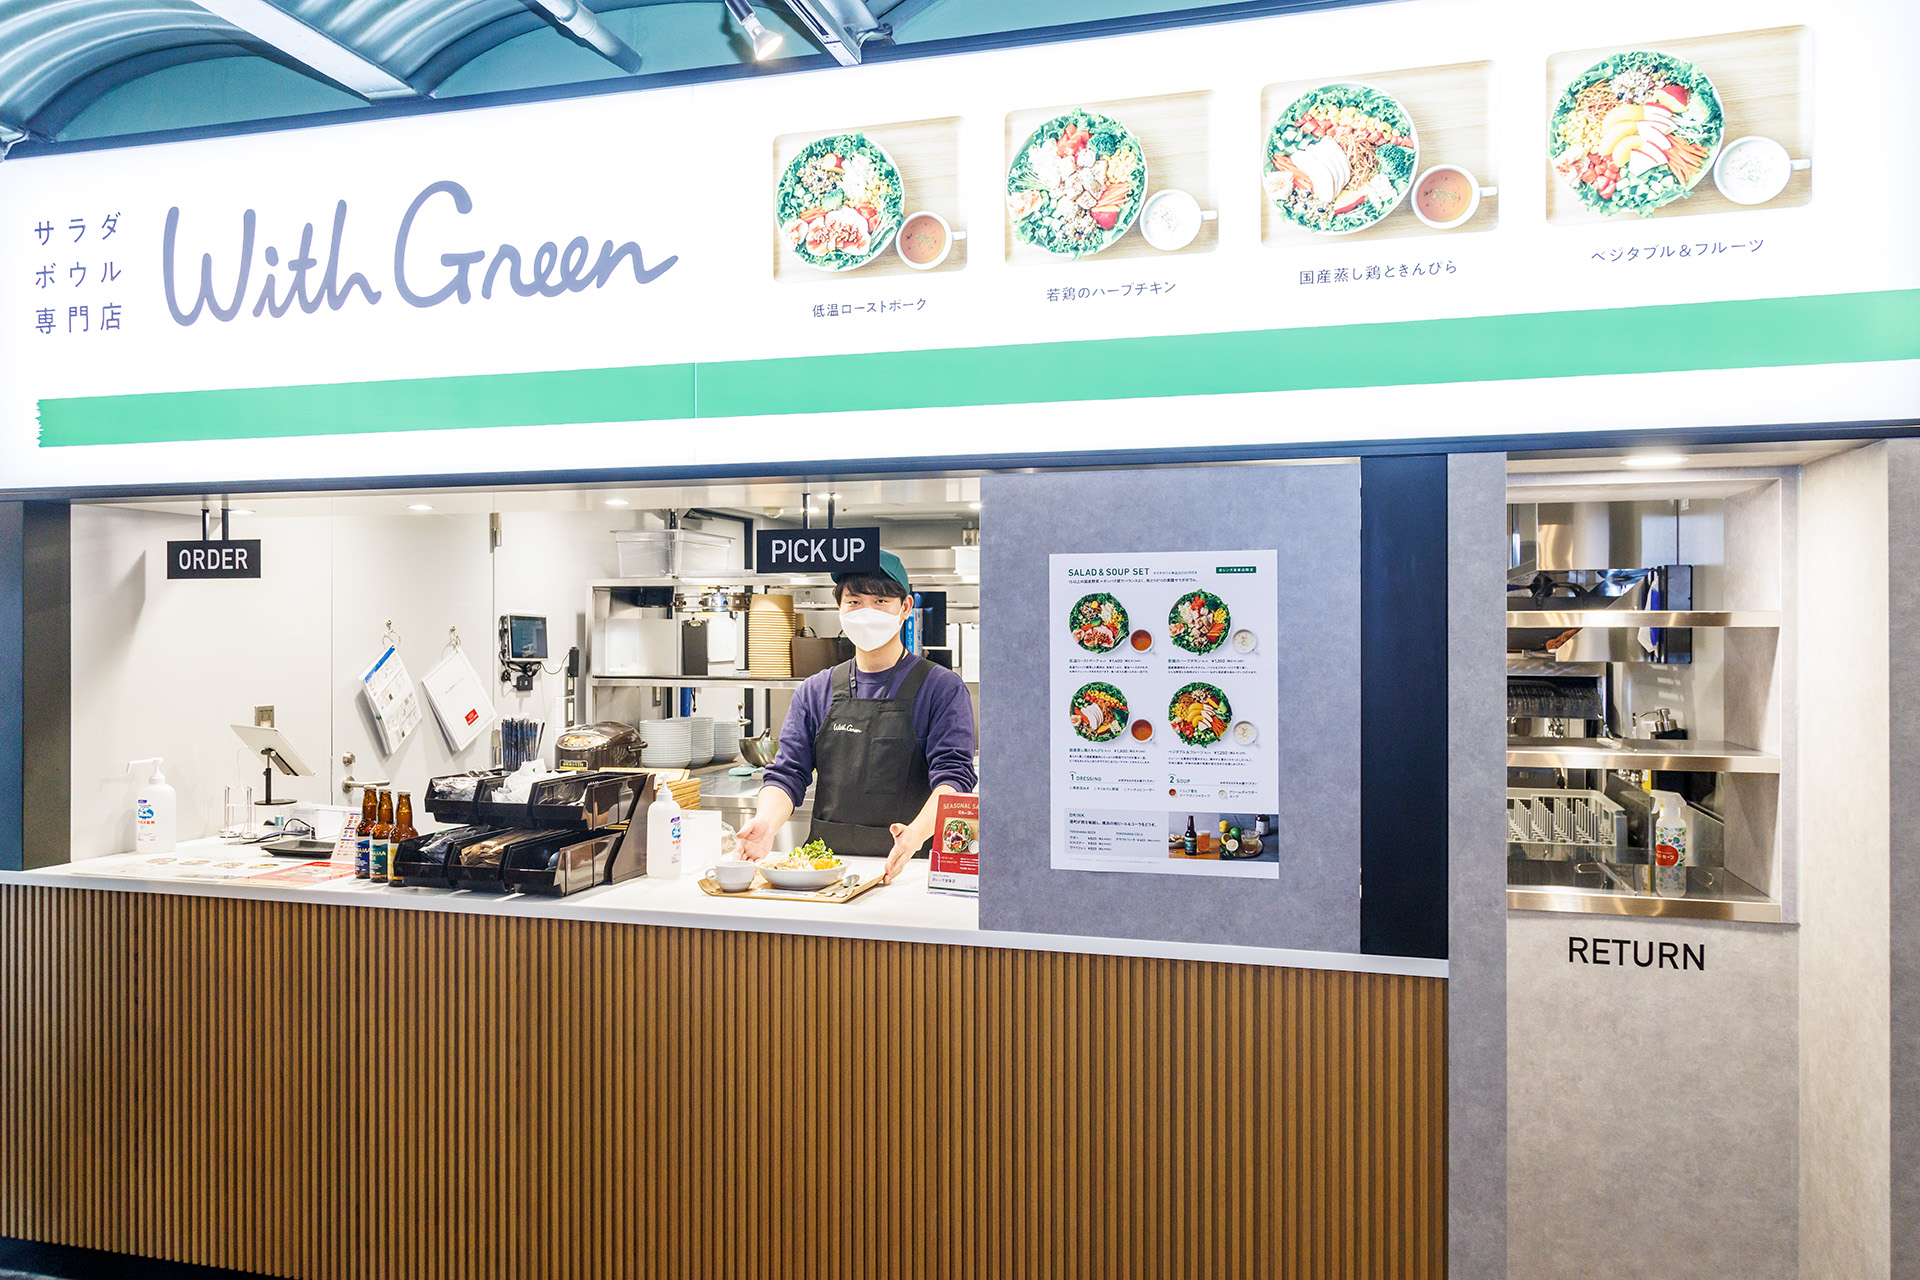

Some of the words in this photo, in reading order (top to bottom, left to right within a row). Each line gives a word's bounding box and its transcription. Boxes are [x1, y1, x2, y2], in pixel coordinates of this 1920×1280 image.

[34, 212, 121, 245] サラダ
[163, 200, 381, 326] With
[394, 181, 678, 308] Green
[35, 261, 121, 288] ボウル
[1299, 260, 1457, 286] 国産蒸し鶏ときんぴら
[1047, 281, 1176, 302] 若鶏のハーブチキン
[35, 302, 122, 335] 専門店
[812, 298, 927, 318] 低温ローストポーク
[179, 548, 248, 570] ORDER
[771, 539, 827, 563] PICK
[833, 538, 865, 562] UP
[1068, 568, 1097, 576] SALAD
[1106, 568, 1130, 576] SOUP
[1133, 568, 1150, 576] SET
[1570, 937, 1704, 970] RETURN
